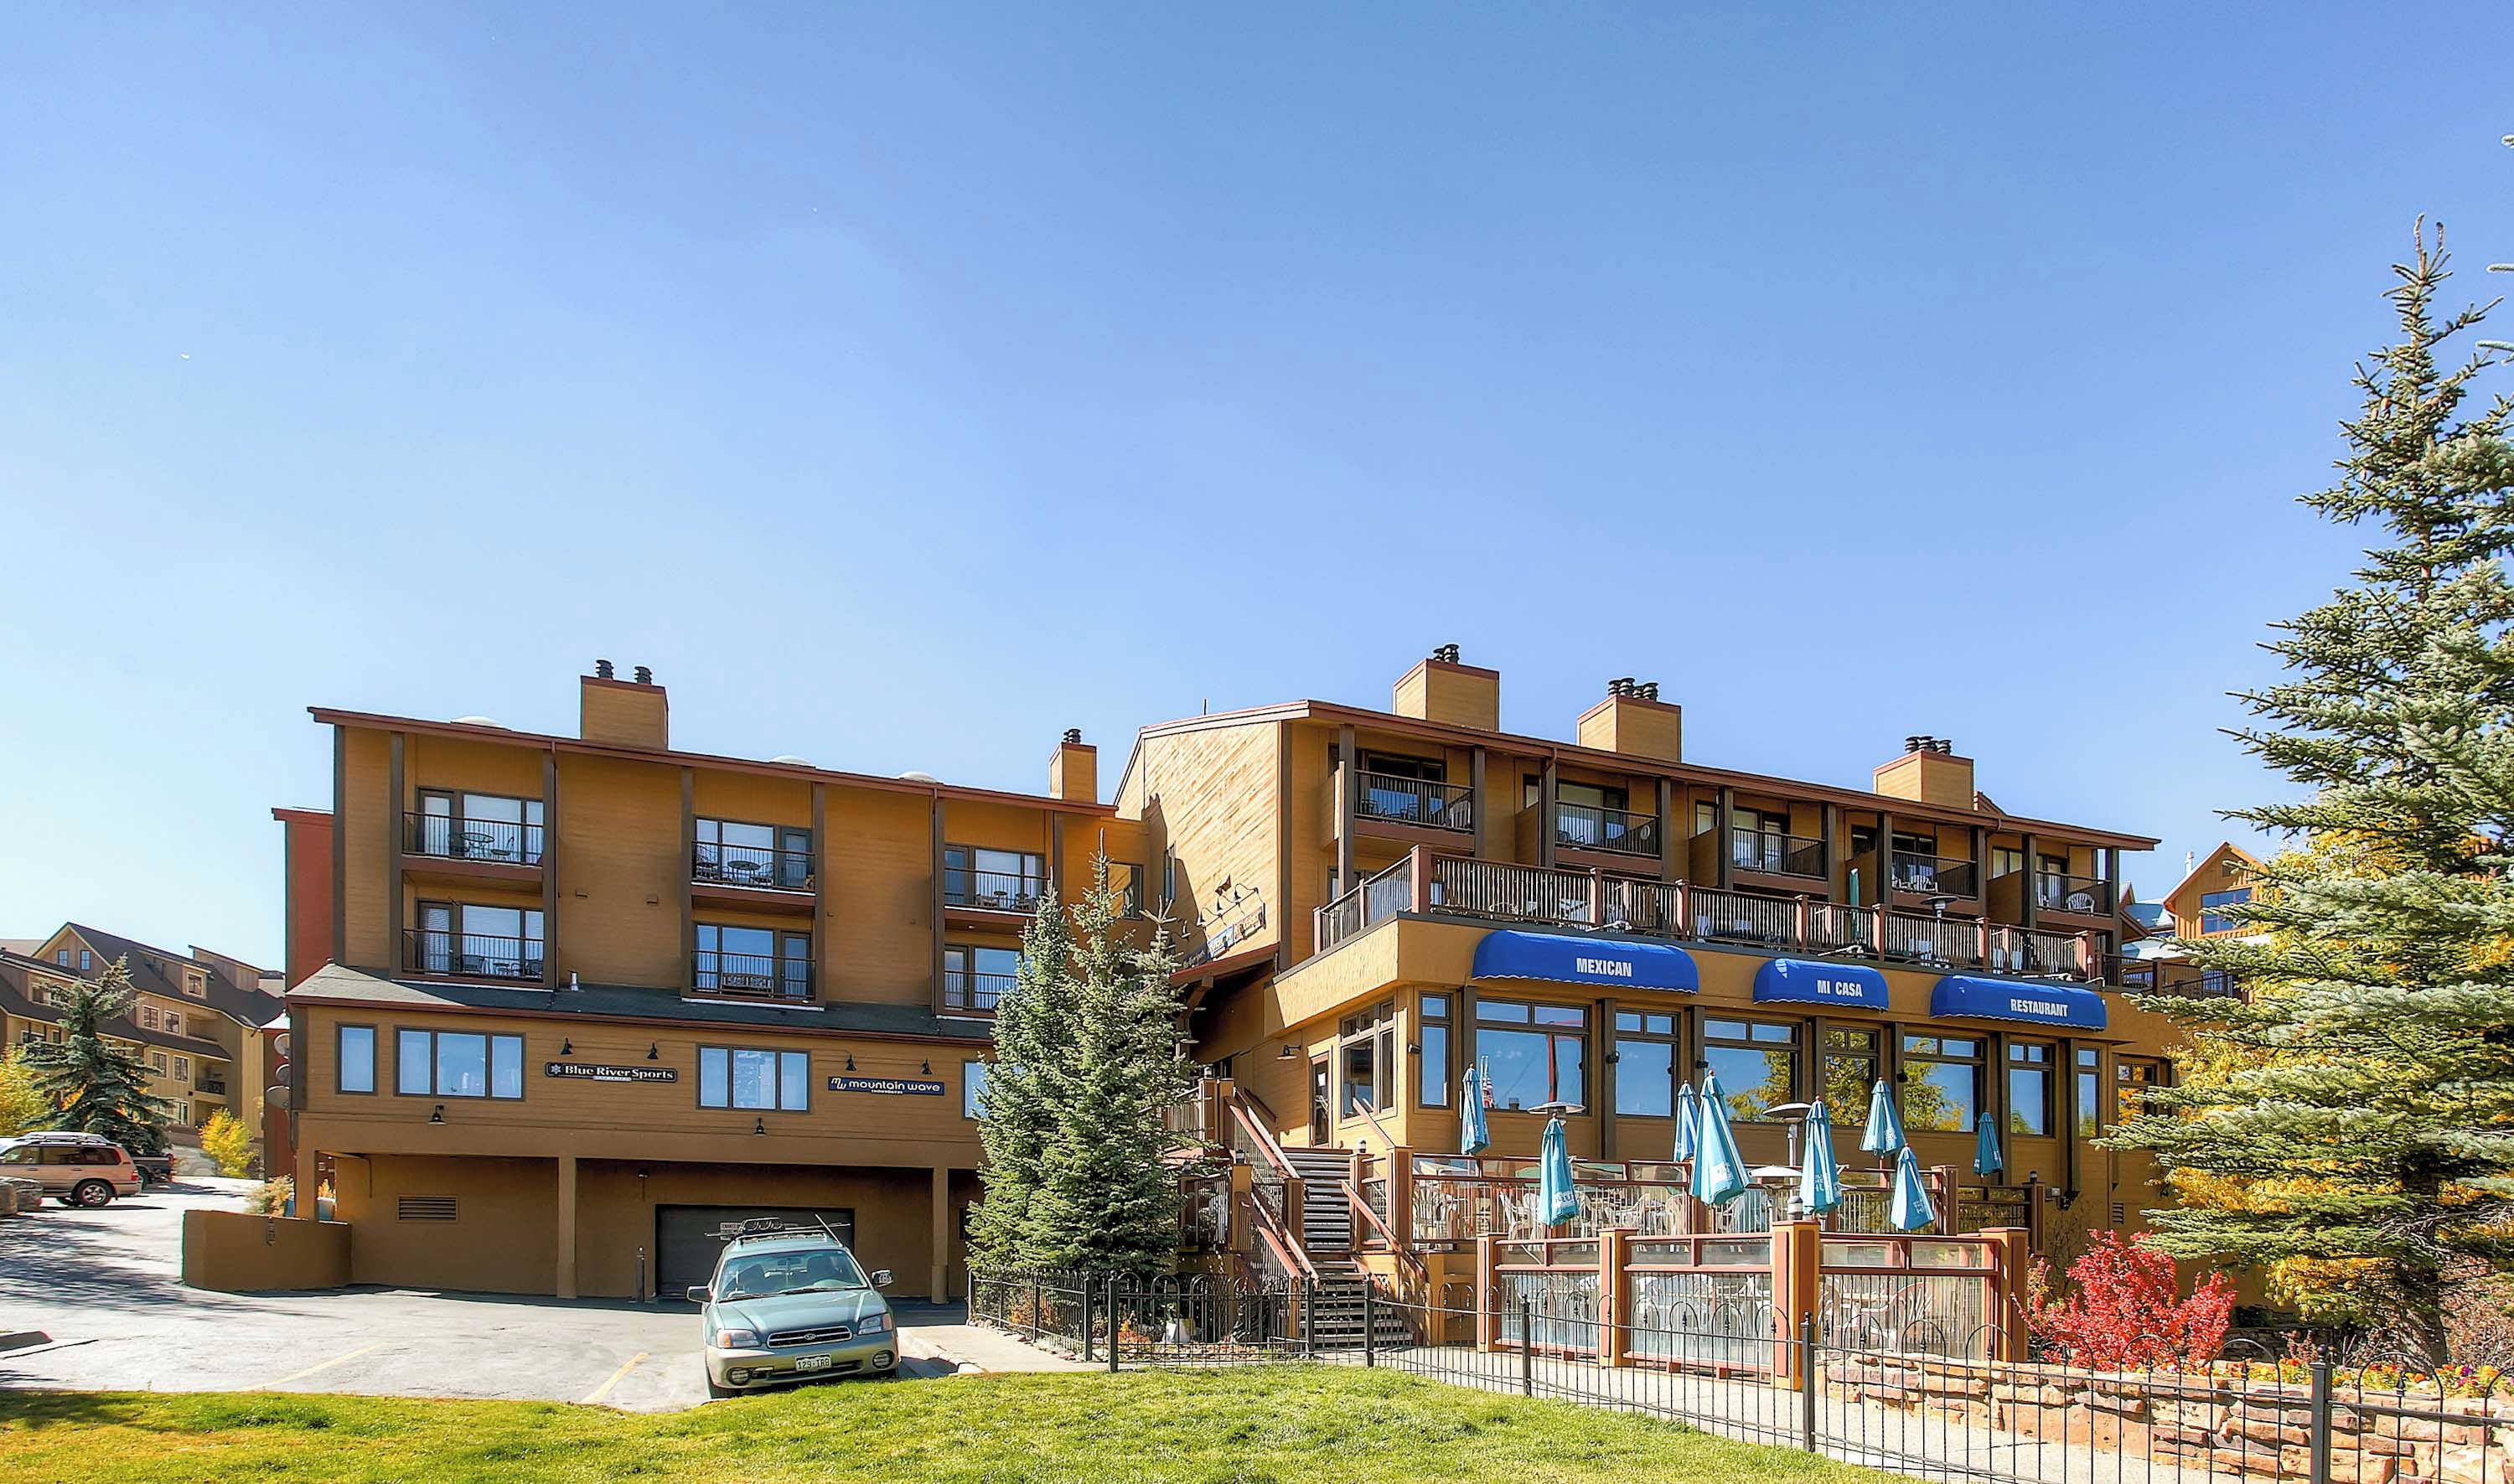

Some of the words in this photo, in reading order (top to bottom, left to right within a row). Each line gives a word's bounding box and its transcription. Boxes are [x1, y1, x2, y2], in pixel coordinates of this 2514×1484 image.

[1576, 958, 1632, 977] MEXICAN
[1817, 980, 1831, 994] MI
[1835, 981, 1863, 997] CASA
[2010, 998, 2068, 1016] RESTAURANT
[565, 1065, 594, 1075] Blue
[596, 1067, 630, 1076] River
[631, 1069, 674, 1079] Sports
[849, 1081, 905, 1090] mountain
